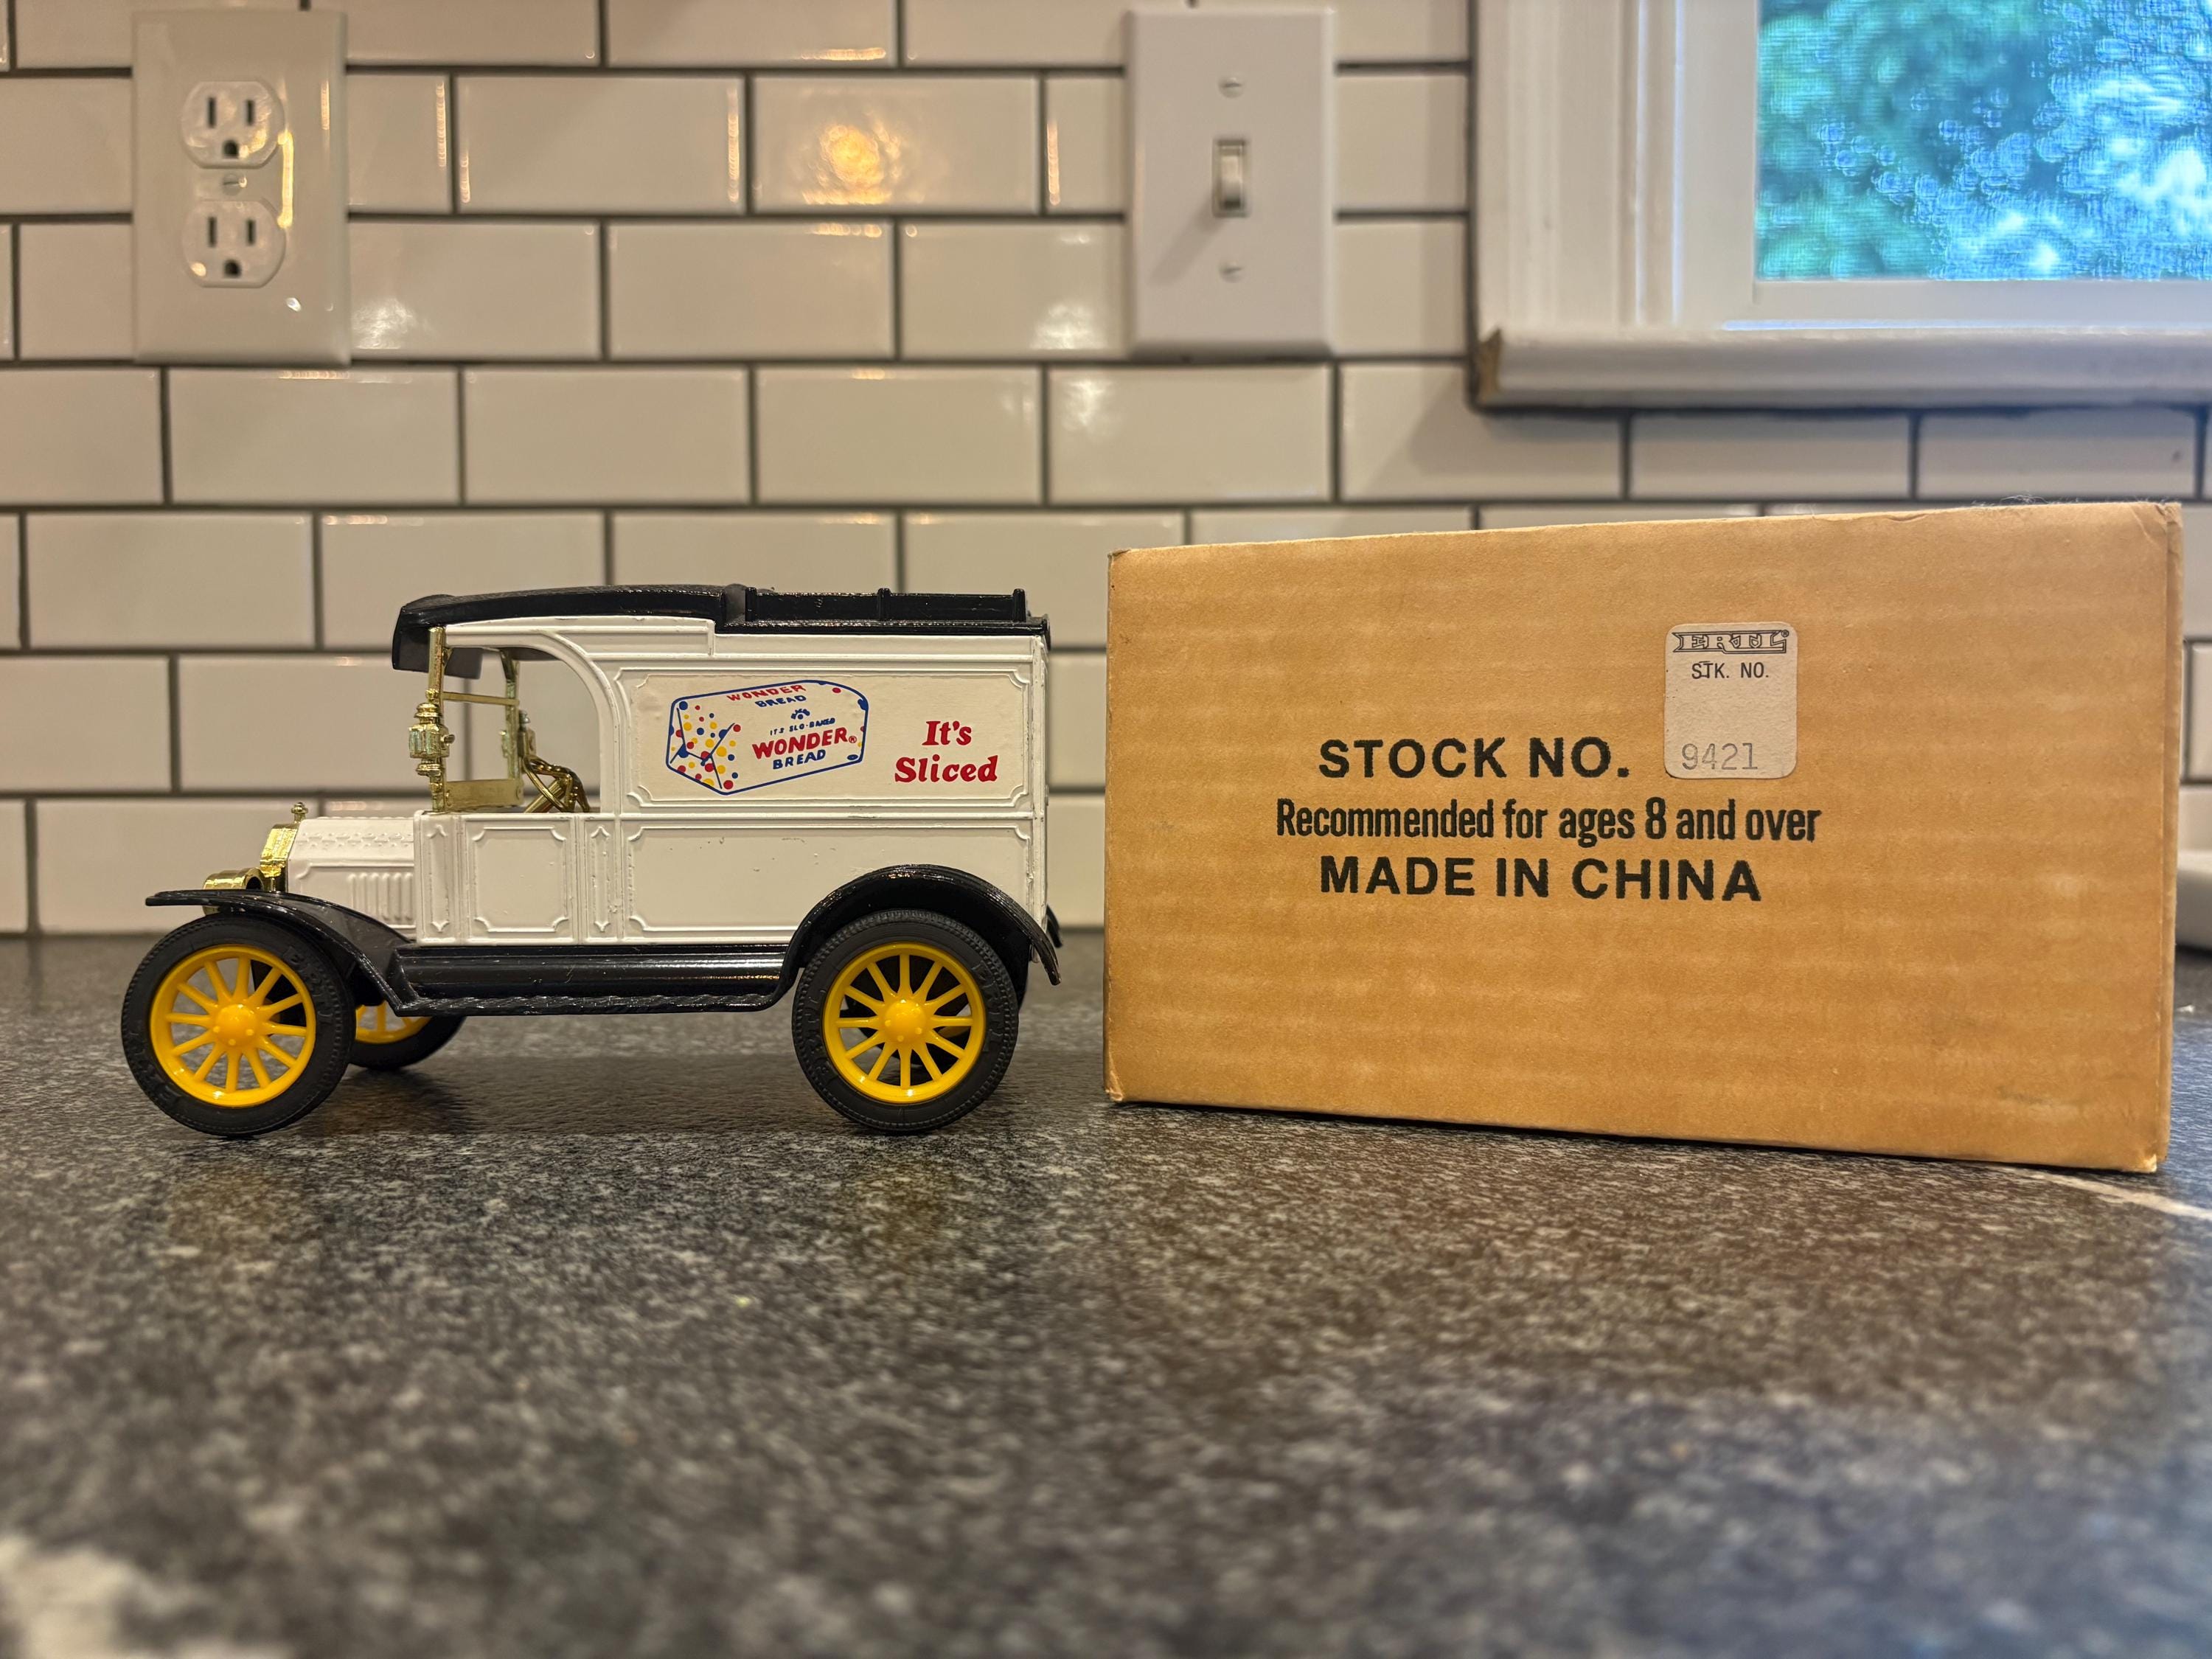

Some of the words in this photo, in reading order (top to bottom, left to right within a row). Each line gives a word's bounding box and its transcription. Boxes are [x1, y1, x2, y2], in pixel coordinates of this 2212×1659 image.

[1691, 661, 1730, 679] STK.
[1740, 662, 1769, 678] NO.
[726, 684, 807, 701] WONDER
[754, 695, 807, 708] BREAD
[922, 720, 972, 745] It's
[773, 749, 827, 770] BREAD
[894, 754, 998, 782] Sliced
[1318, 737, 1507, 779] STOCK
[1529, 737, 1630, 779] NO.
[1681, 742, 1759, 771] 9421
[1276, 798, 1494, 838] Recommended
[1502, 798, 1548, 838] for
[1559, 807, 1635, 848] ages
[1645, 796, 1667, 839] 8
[1676, 799, 1735, 841] and
[1745, 808, 1821, 843] over
[1320, 855, 1475, 897] MADE
[1495, 858, 1548, 898] IN
[1571, 858, 1762, 901] CHINA
